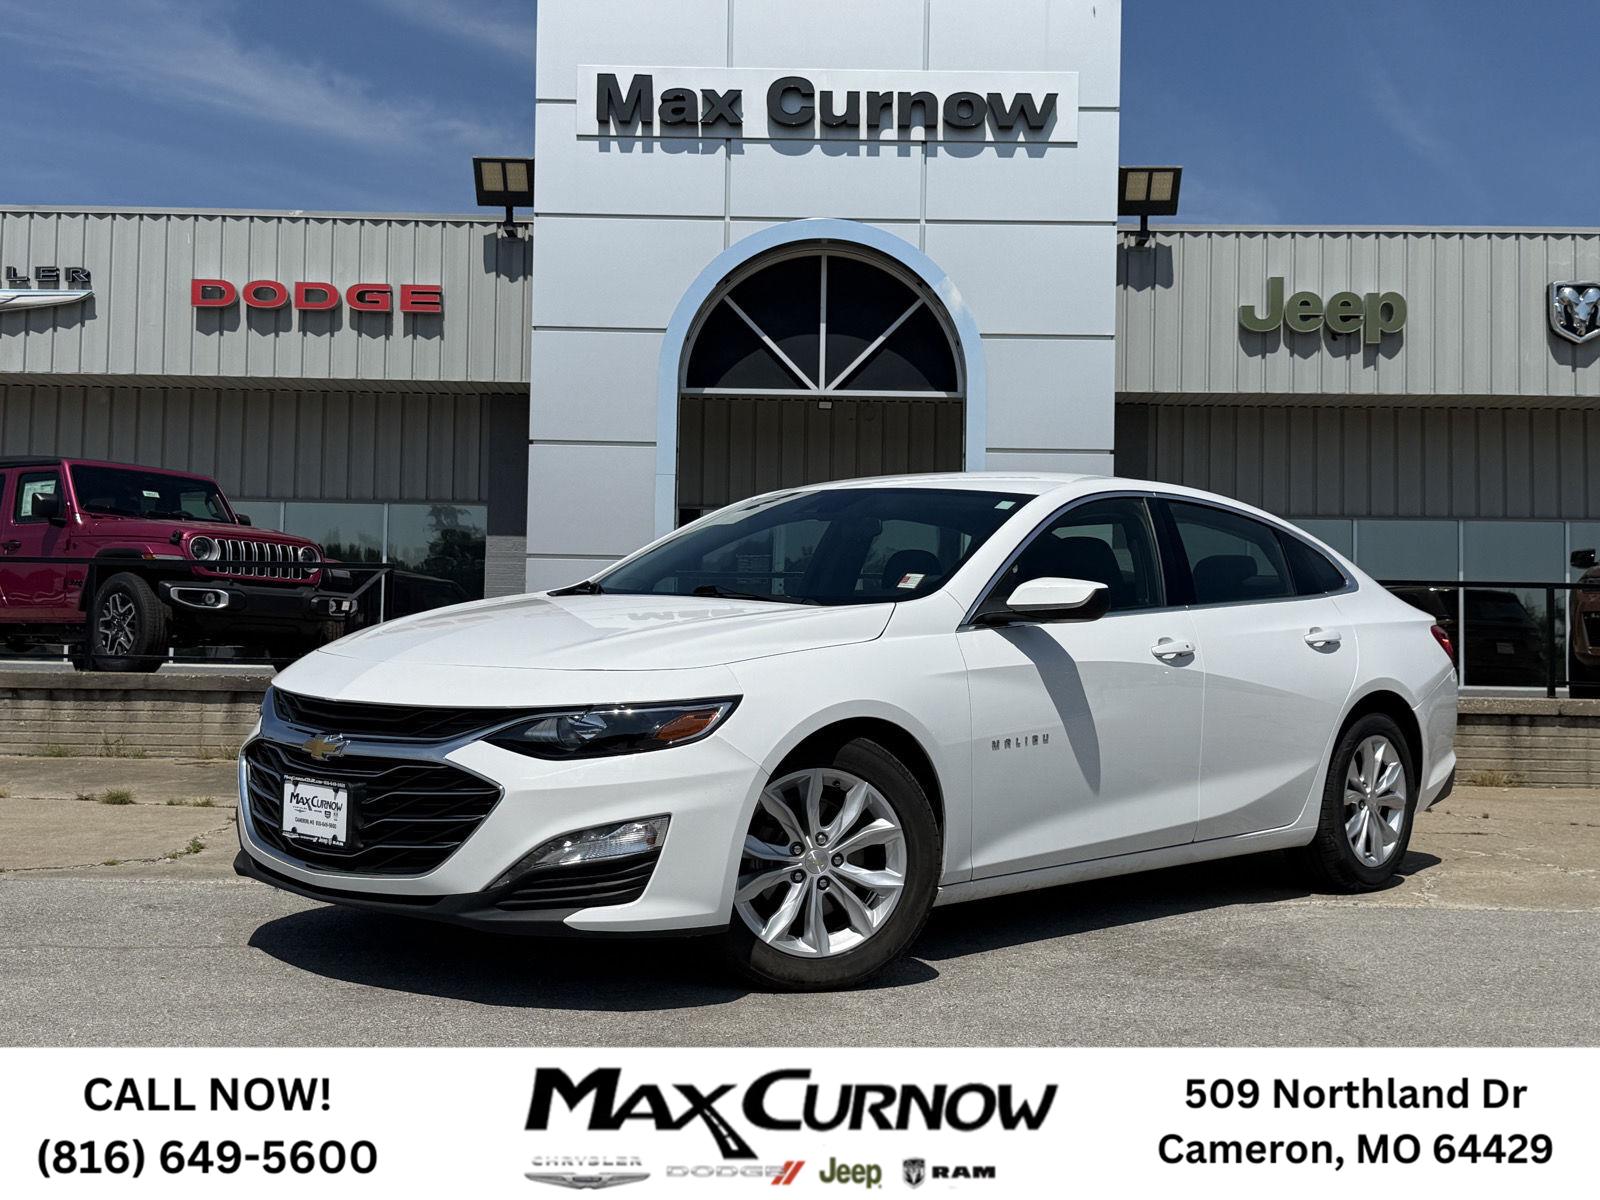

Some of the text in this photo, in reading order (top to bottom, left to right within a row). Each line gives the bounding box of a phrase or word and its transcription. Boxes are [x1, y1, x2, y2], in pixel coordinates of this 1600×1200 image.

[596, 73, 1059, 130] Max Curnow
[191, 278, 442, 312] DODGE
[1238, 276, 1408, 343] Jeep
[991, 733, 1049, 751] MALIBU
